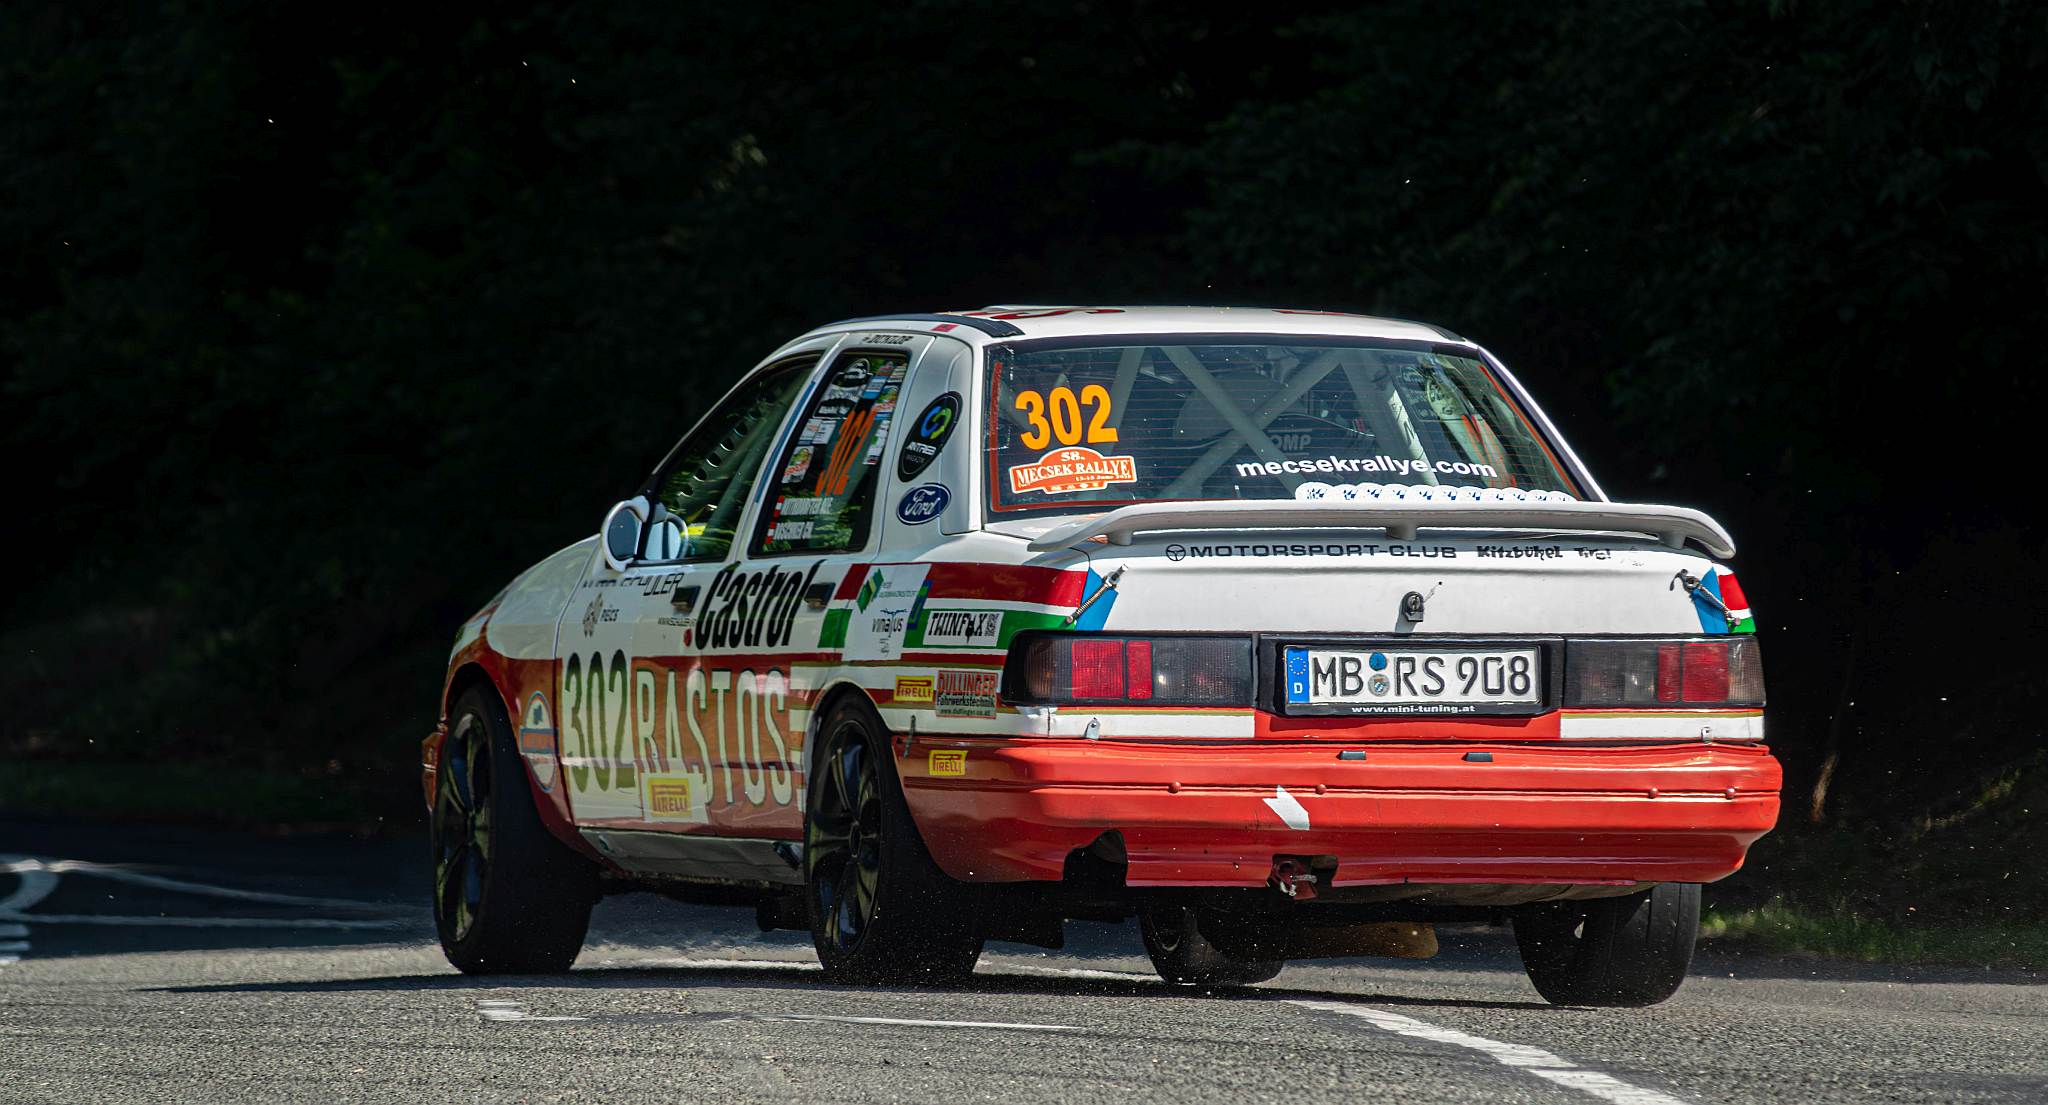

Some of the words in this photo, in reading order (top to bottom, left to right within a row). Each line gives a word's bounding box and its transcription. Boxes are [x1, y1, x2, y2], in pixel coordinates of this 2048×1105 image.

[1015, 384, 1119, 450] 302
[814, 409, 876, 496] 302
[1016, 463, 1073, 485] MECSEK
[1074, 459, 1131, 476] RALLYE
[1235, 454, 1498, 479] mecsekrallye.com
[905, 489, 939, 517] Ford
[1190, 544, 1458, 559] MOTORSPORT-CLUB
[1476, 545, 1563, 561] Kitzbühel
[694, 559, 826, 651] Castrol
[896, 679, 933, 699] PIRELLI
[937, 673, 997, 698] DULLINGER
[1293, 682, 1303, 694] D
[1312, 656, 1363, 697] MB
[1395, 656, 1445, 697] RS
[1456, 655, 1530, 697] 908
[564, 649, 636, 793] 302
[1351, 703, 1476, 714] www.mini-tuning.at
[934, 753, 962, 773] PIRELLI
[651, 785, 688, 812] PIRELLI
